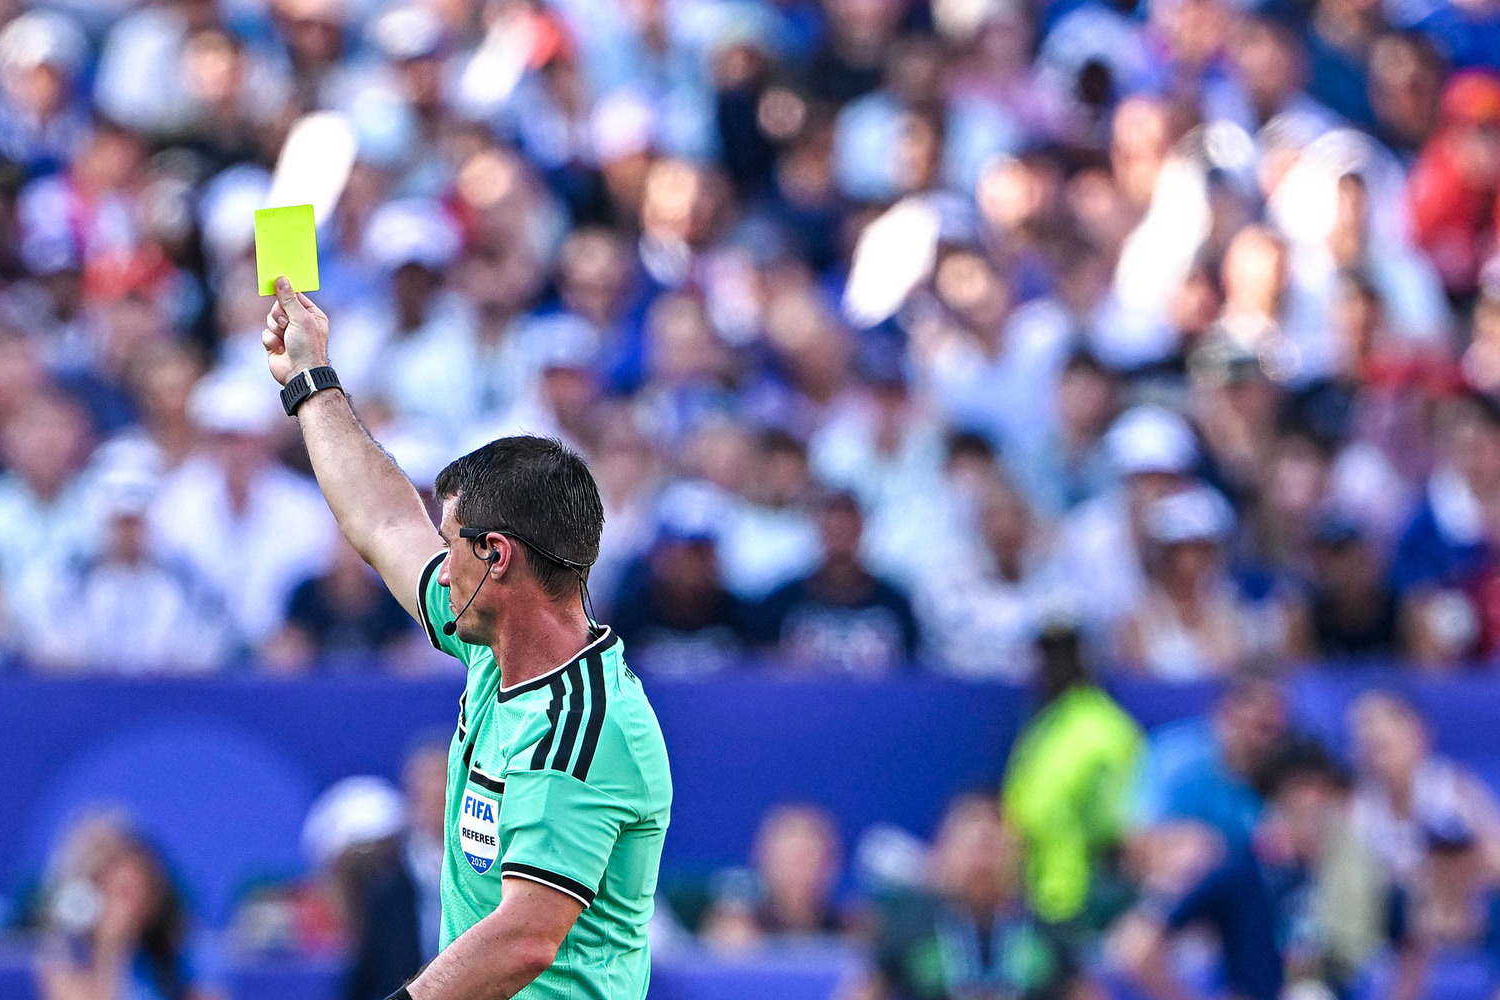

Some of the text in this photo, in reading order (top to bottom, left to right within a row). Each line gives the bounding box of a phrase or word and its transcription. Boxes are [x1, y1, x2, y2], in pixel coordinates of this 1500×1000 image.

[464, 795, 495, 824] FIFA
[462, 827, 496, 847] REFEREE
[471, 856, 487, 869] 2026
